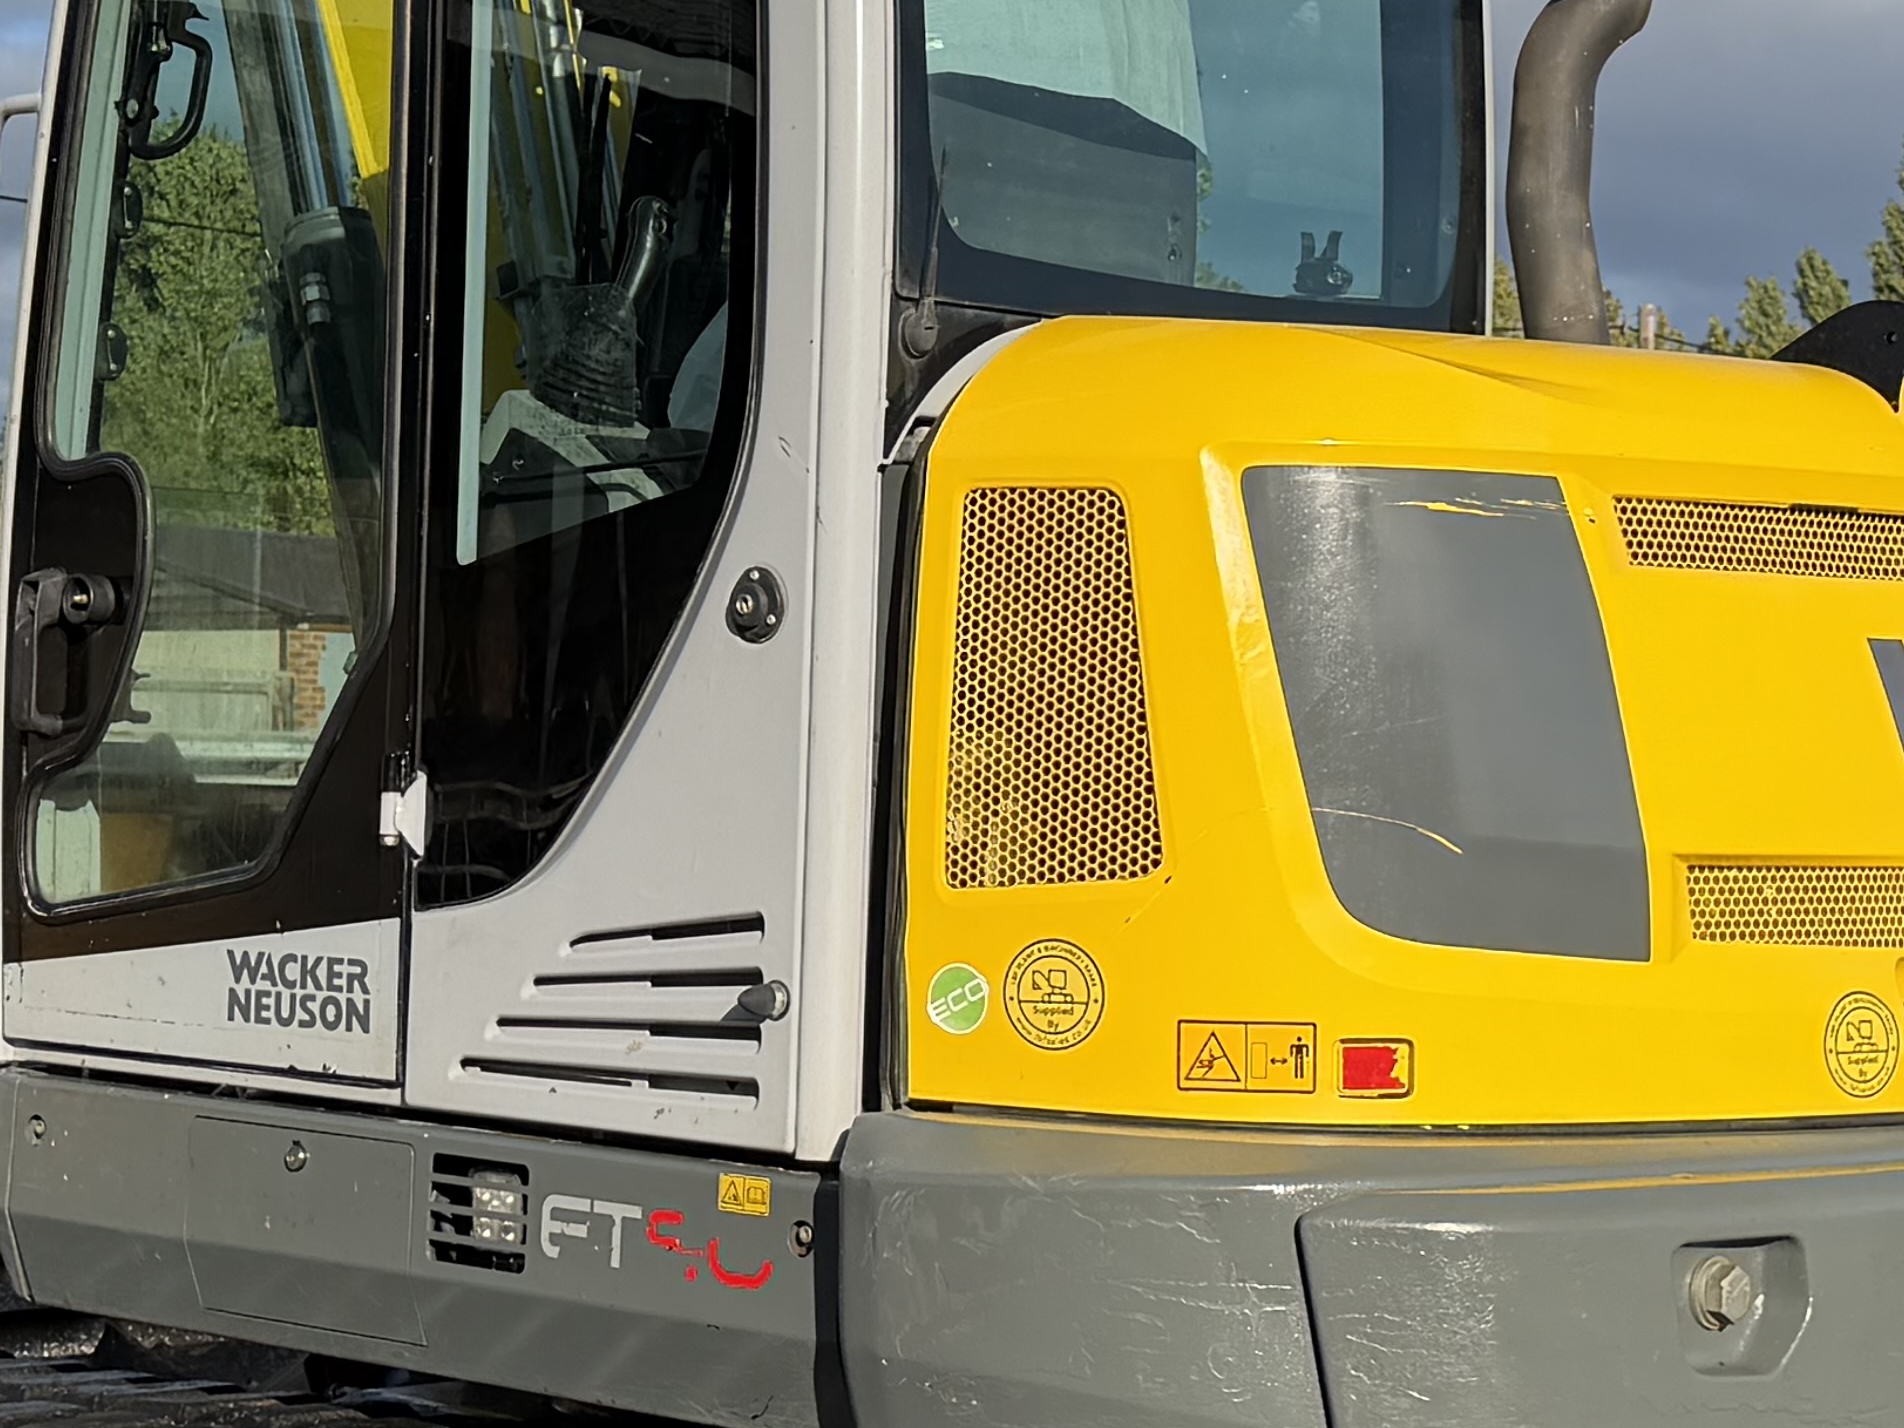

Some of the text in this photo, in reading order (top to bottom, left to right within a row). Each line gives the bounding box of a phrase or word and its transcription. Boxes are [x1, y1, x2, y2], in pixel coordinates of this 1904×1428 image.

[226, 948, 371, 995] WACKER
[227, 987, 371, 1034] NEUSON
[927, 978, 988, 1023] ECO
